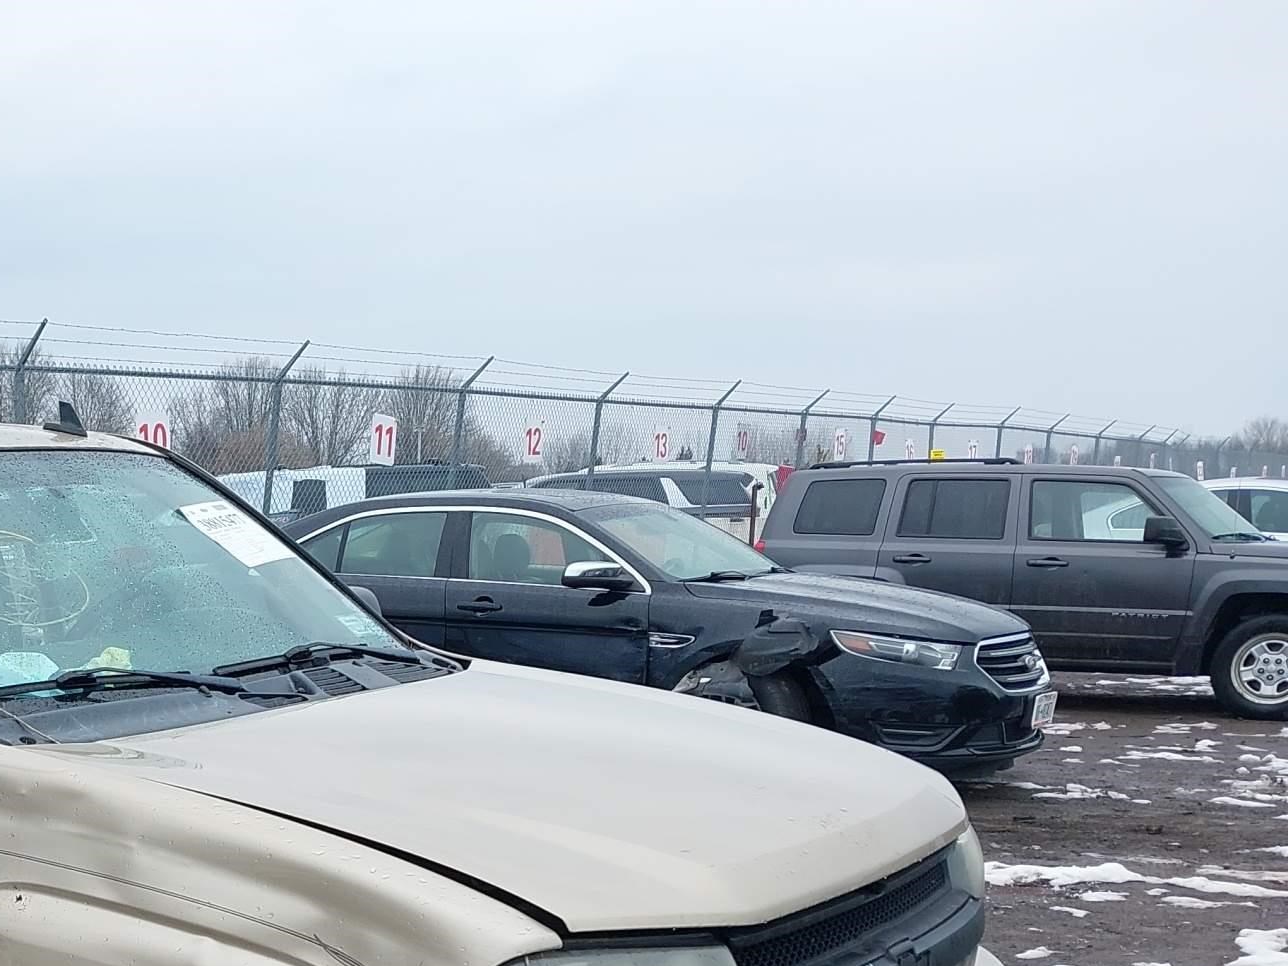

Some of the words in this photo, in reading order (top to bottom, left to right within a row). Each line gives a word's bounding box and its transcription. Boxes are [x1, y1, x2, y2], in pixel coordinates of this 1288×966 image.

[139, 423, 167, 448] 10
[375, 424, 393, 457] 11
[526, 427, 541, 455] 12
[655, 433, 668, 458] 13
[737, 431, 748, 451] 10
[836, 434, 844, 455] 15
